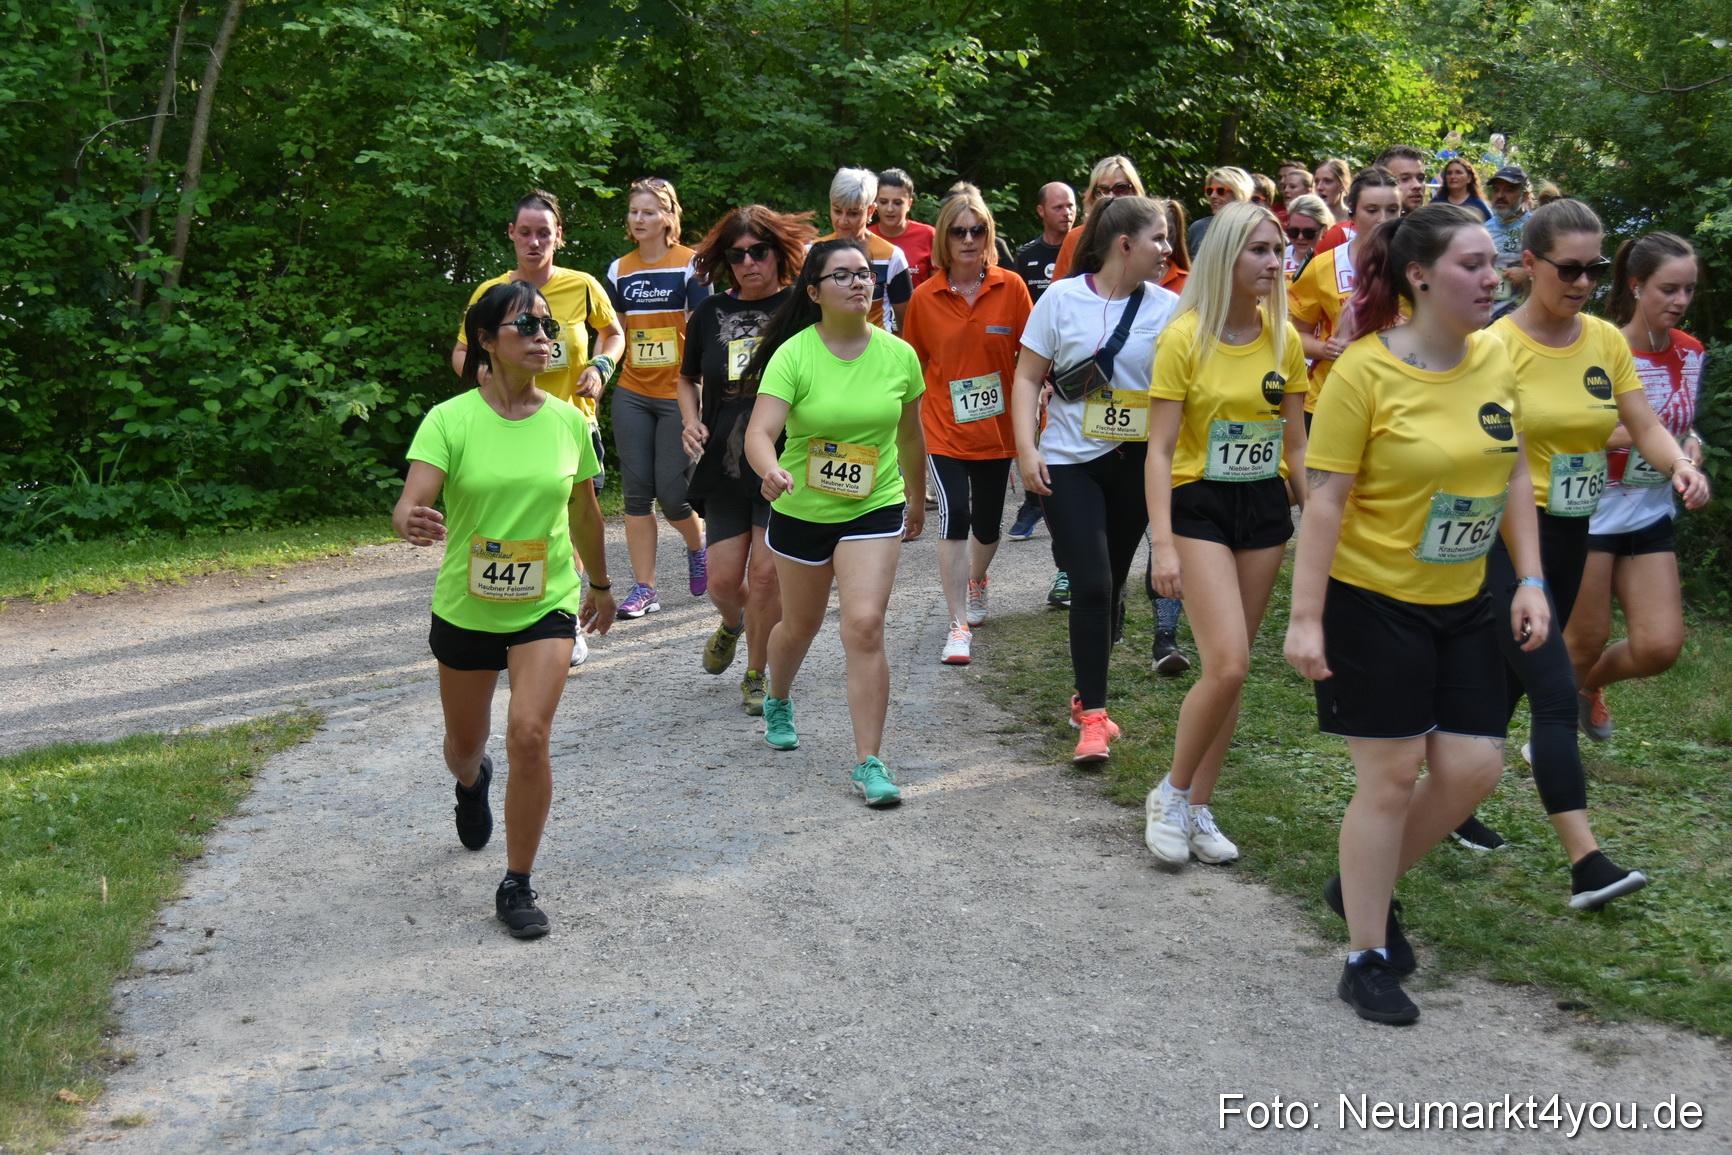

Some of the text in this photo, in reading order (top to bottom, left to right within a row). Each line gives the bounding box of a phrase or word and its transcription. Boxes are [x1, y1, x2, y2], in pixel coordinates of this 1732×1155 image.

[632, 288, 673, 298] Fischer
[638, 342, 664, 357] 771
[960, 389, 998, 410] 1799
[1104, 408, 1130, 426] 85
[1218, 442, 1274, 465] 1766
[820, 460, 862, 483] 448
[1561, 472, 1604, 499] 1765
[1438, 516, 1496, 545] 1762
[482, 562, 531, 585] 447
[478, 583, 505, 592] Haubner
